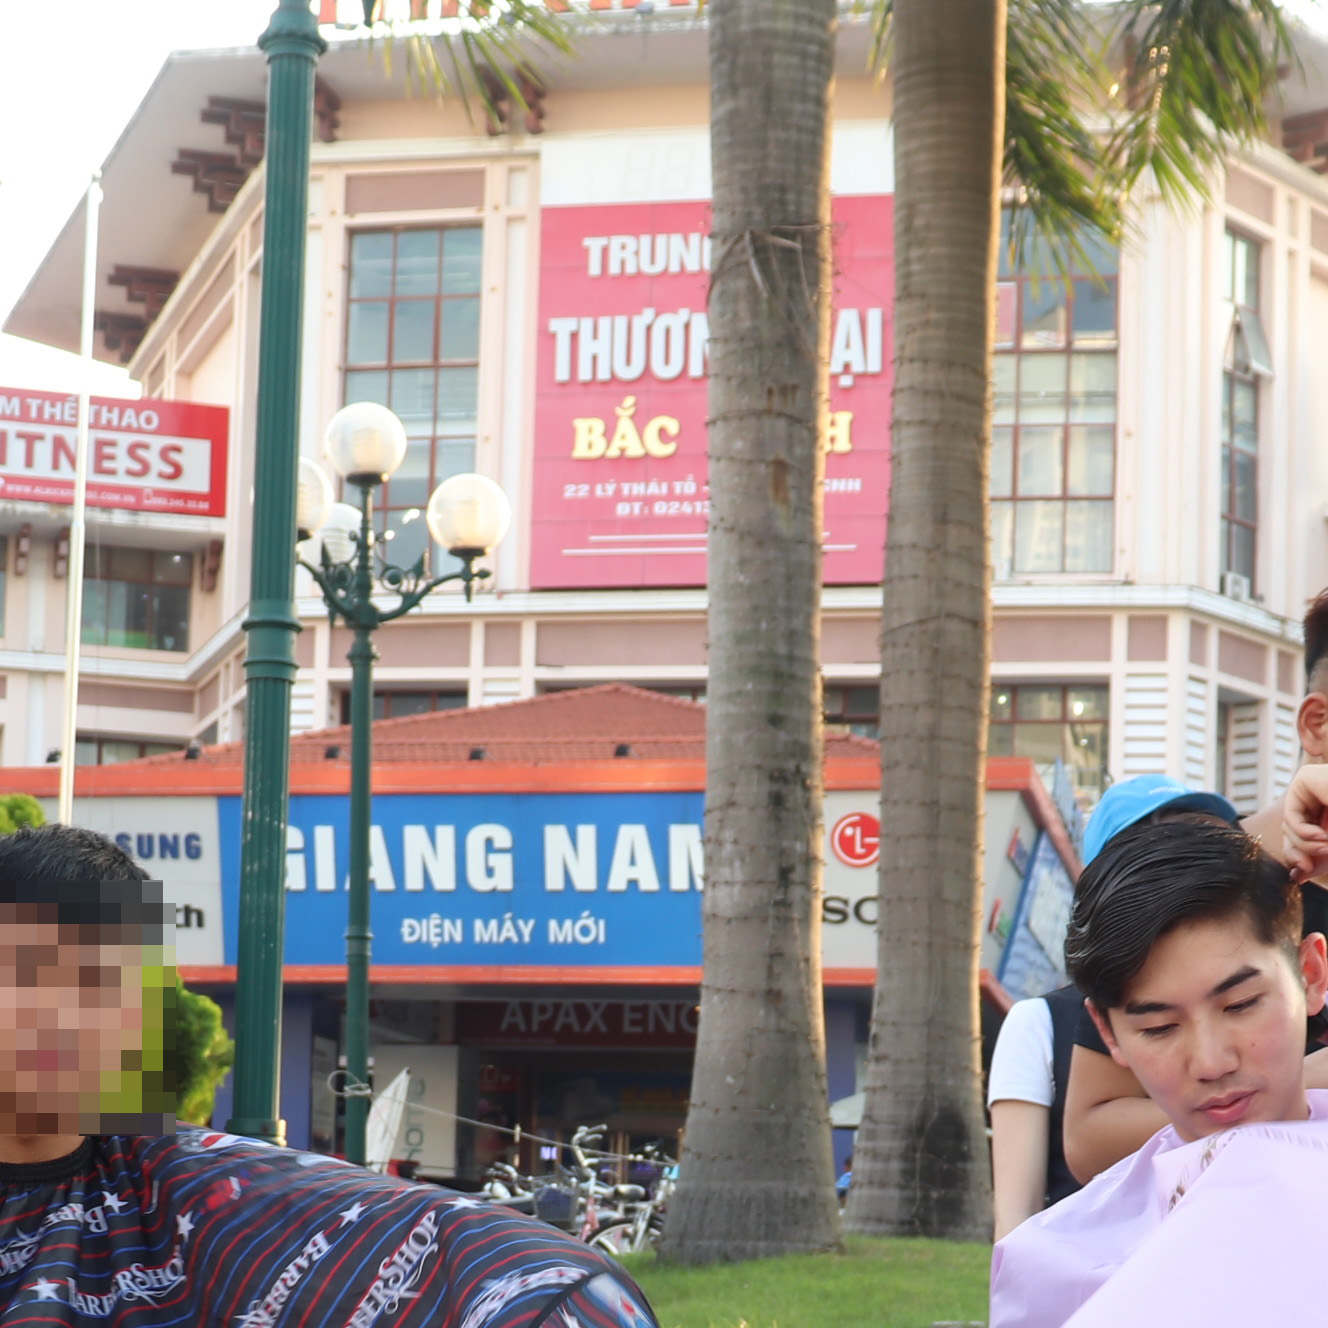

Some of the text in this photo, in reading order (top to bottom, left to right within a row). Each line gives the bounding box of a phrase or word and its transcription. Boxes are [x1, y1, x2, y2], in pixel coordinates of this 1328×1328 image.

[582, 231, 711, 278] TRUN
[548, 306, 883, 389] THƯƠN ẠI
[88, 403, 160, 431] THAO
[571, 394, 681, 460] BẮC
[564, 484, 590, 498] 22
[596, 478, 617, 497] LÝ
[620, 478, 668, 497] THÁI
[115, 832, 203, 861] SUNG
[543, 822, 706, 893] NAM
[401, 909, 607, 949] ĐIỆN MÁY MỚI
[500, 999, 609, 1034] APAX
[65, 1244, 187, 1317] BARERSHO
